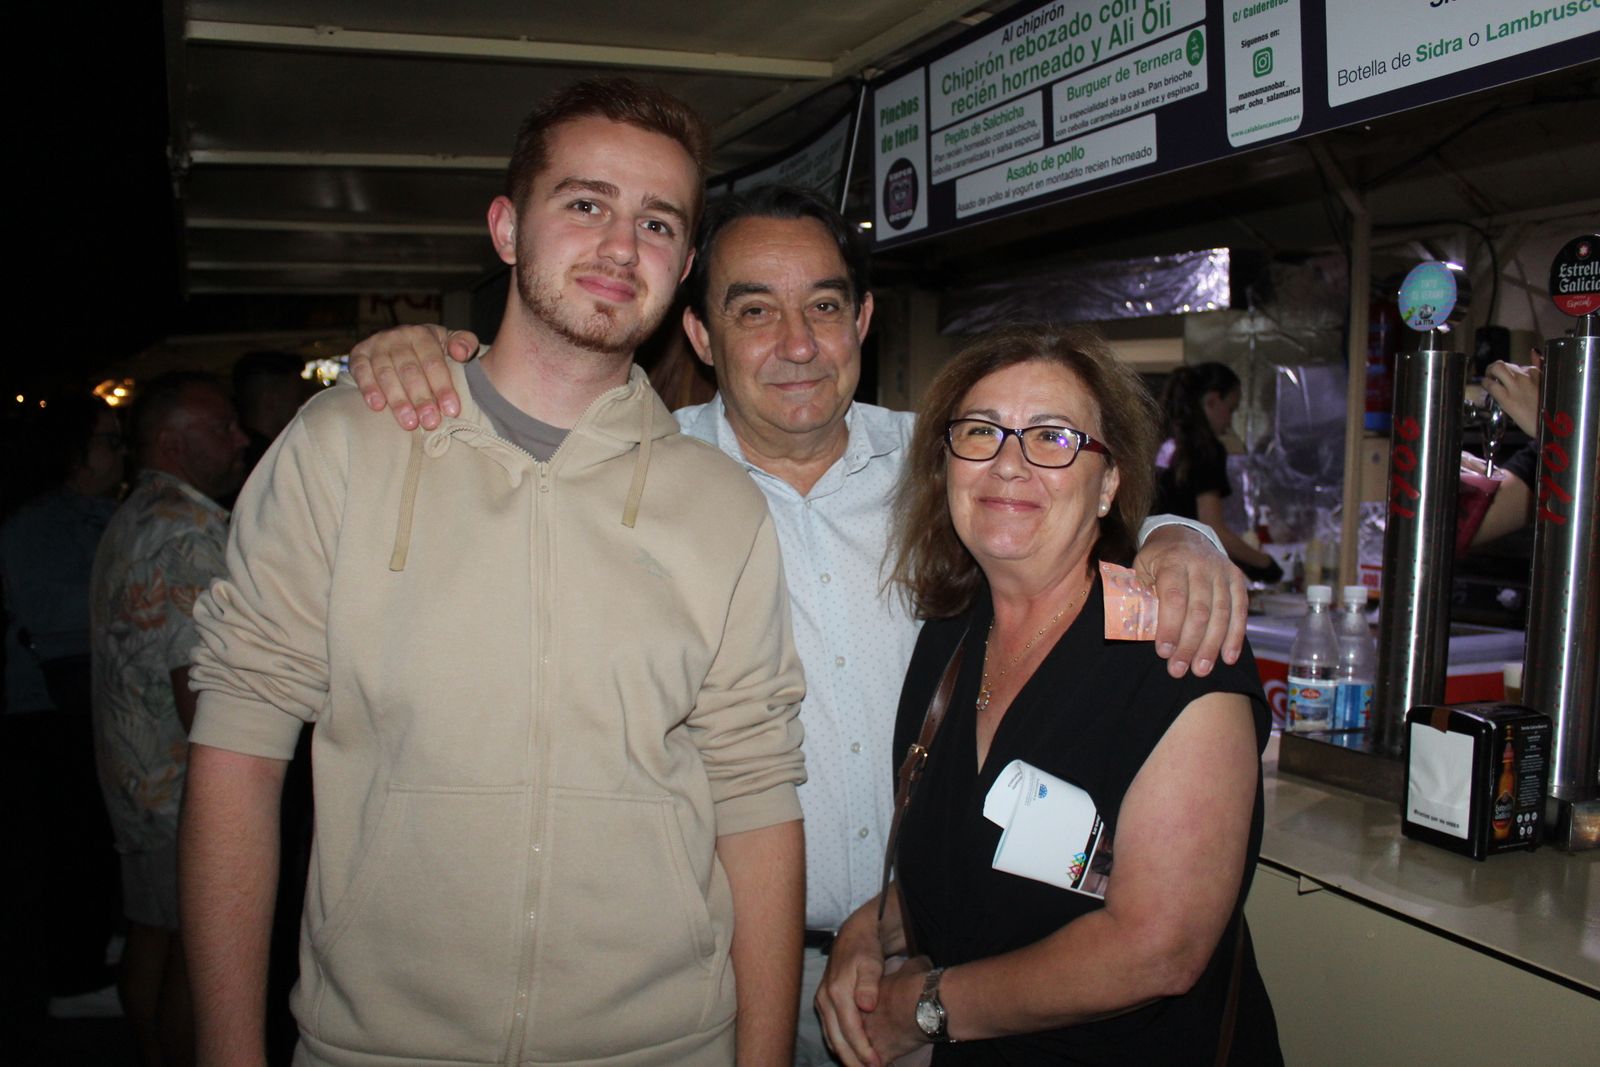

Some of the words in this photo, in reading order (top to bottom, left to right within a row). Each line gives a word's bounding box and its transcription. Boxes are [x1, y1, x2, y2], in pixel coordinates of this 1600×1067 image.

[1002, 26, 1013, 44] Al
[1016, 4, 1064, 38] chipirón
[1270, 28, 1280, 38] en:
[942, 52, 1004, 96] Chipirón
[1010, 11, 1092, 64] rebozado
[952, 80, 996, 116] recién
[1002, 43, 1085, 94] horneado
[1091, 36, 1102, 62] y
[1108, 17, 1134, 50] Ali
[1142, 1, 1171, 34] Oli
[1066, 74, 1112, 102] Burguer
[1115, 66, 1130, 84] de
[1134, 47, 1182, 76] Ternera
[1338, 59, 1386, 86] Botella
[1392, 52, 1410, 69] de
[1416, 37, 1462, 62] Sidra
[1468, 32, 1479, 47] o
[880, 96, 919, 128] Pinchos
[1060, 114, 1068, 123] La
[1069, 98, 1108, 121] especialidad
[1110, 96, 1118, 106] de
[1120, 92, 1126, 102] la
[1148, 80, 1162, 92] Pan
[1164, 70, 1192, 86] brioche
[1068, 120, 1088, 133] cebolla
[1090, 106, 1132, 125] caramelizada
[1134, 102, 1140, 110] al
[1167, 82, 1200, 100] espinaca
[882, 134, 892, 153] de
[944, 128, 969, 146] Pepito
[970, 122, 980, 136] de
[983, 106, 1024, 131] Salchicha
[957, 200, 976, 212] Asado
[978, 197, 986, 206] de
[987, 193, 1002, 206] pollo
[1004, 190, 1010, 199] al
[1012, 182, 1034, 199] yogurt
[1035, 180, 1044, 190] en
[1046, 167, 1083, 186] montadito
[1112, 146, 1152, 167] horneado
[1006, 164, 1038, 182] Asado
[1041, 156, 1054, 170] de
[1058, 146, 1084, 170] pollo
[1558, 261, 1600, 278] Estrell
